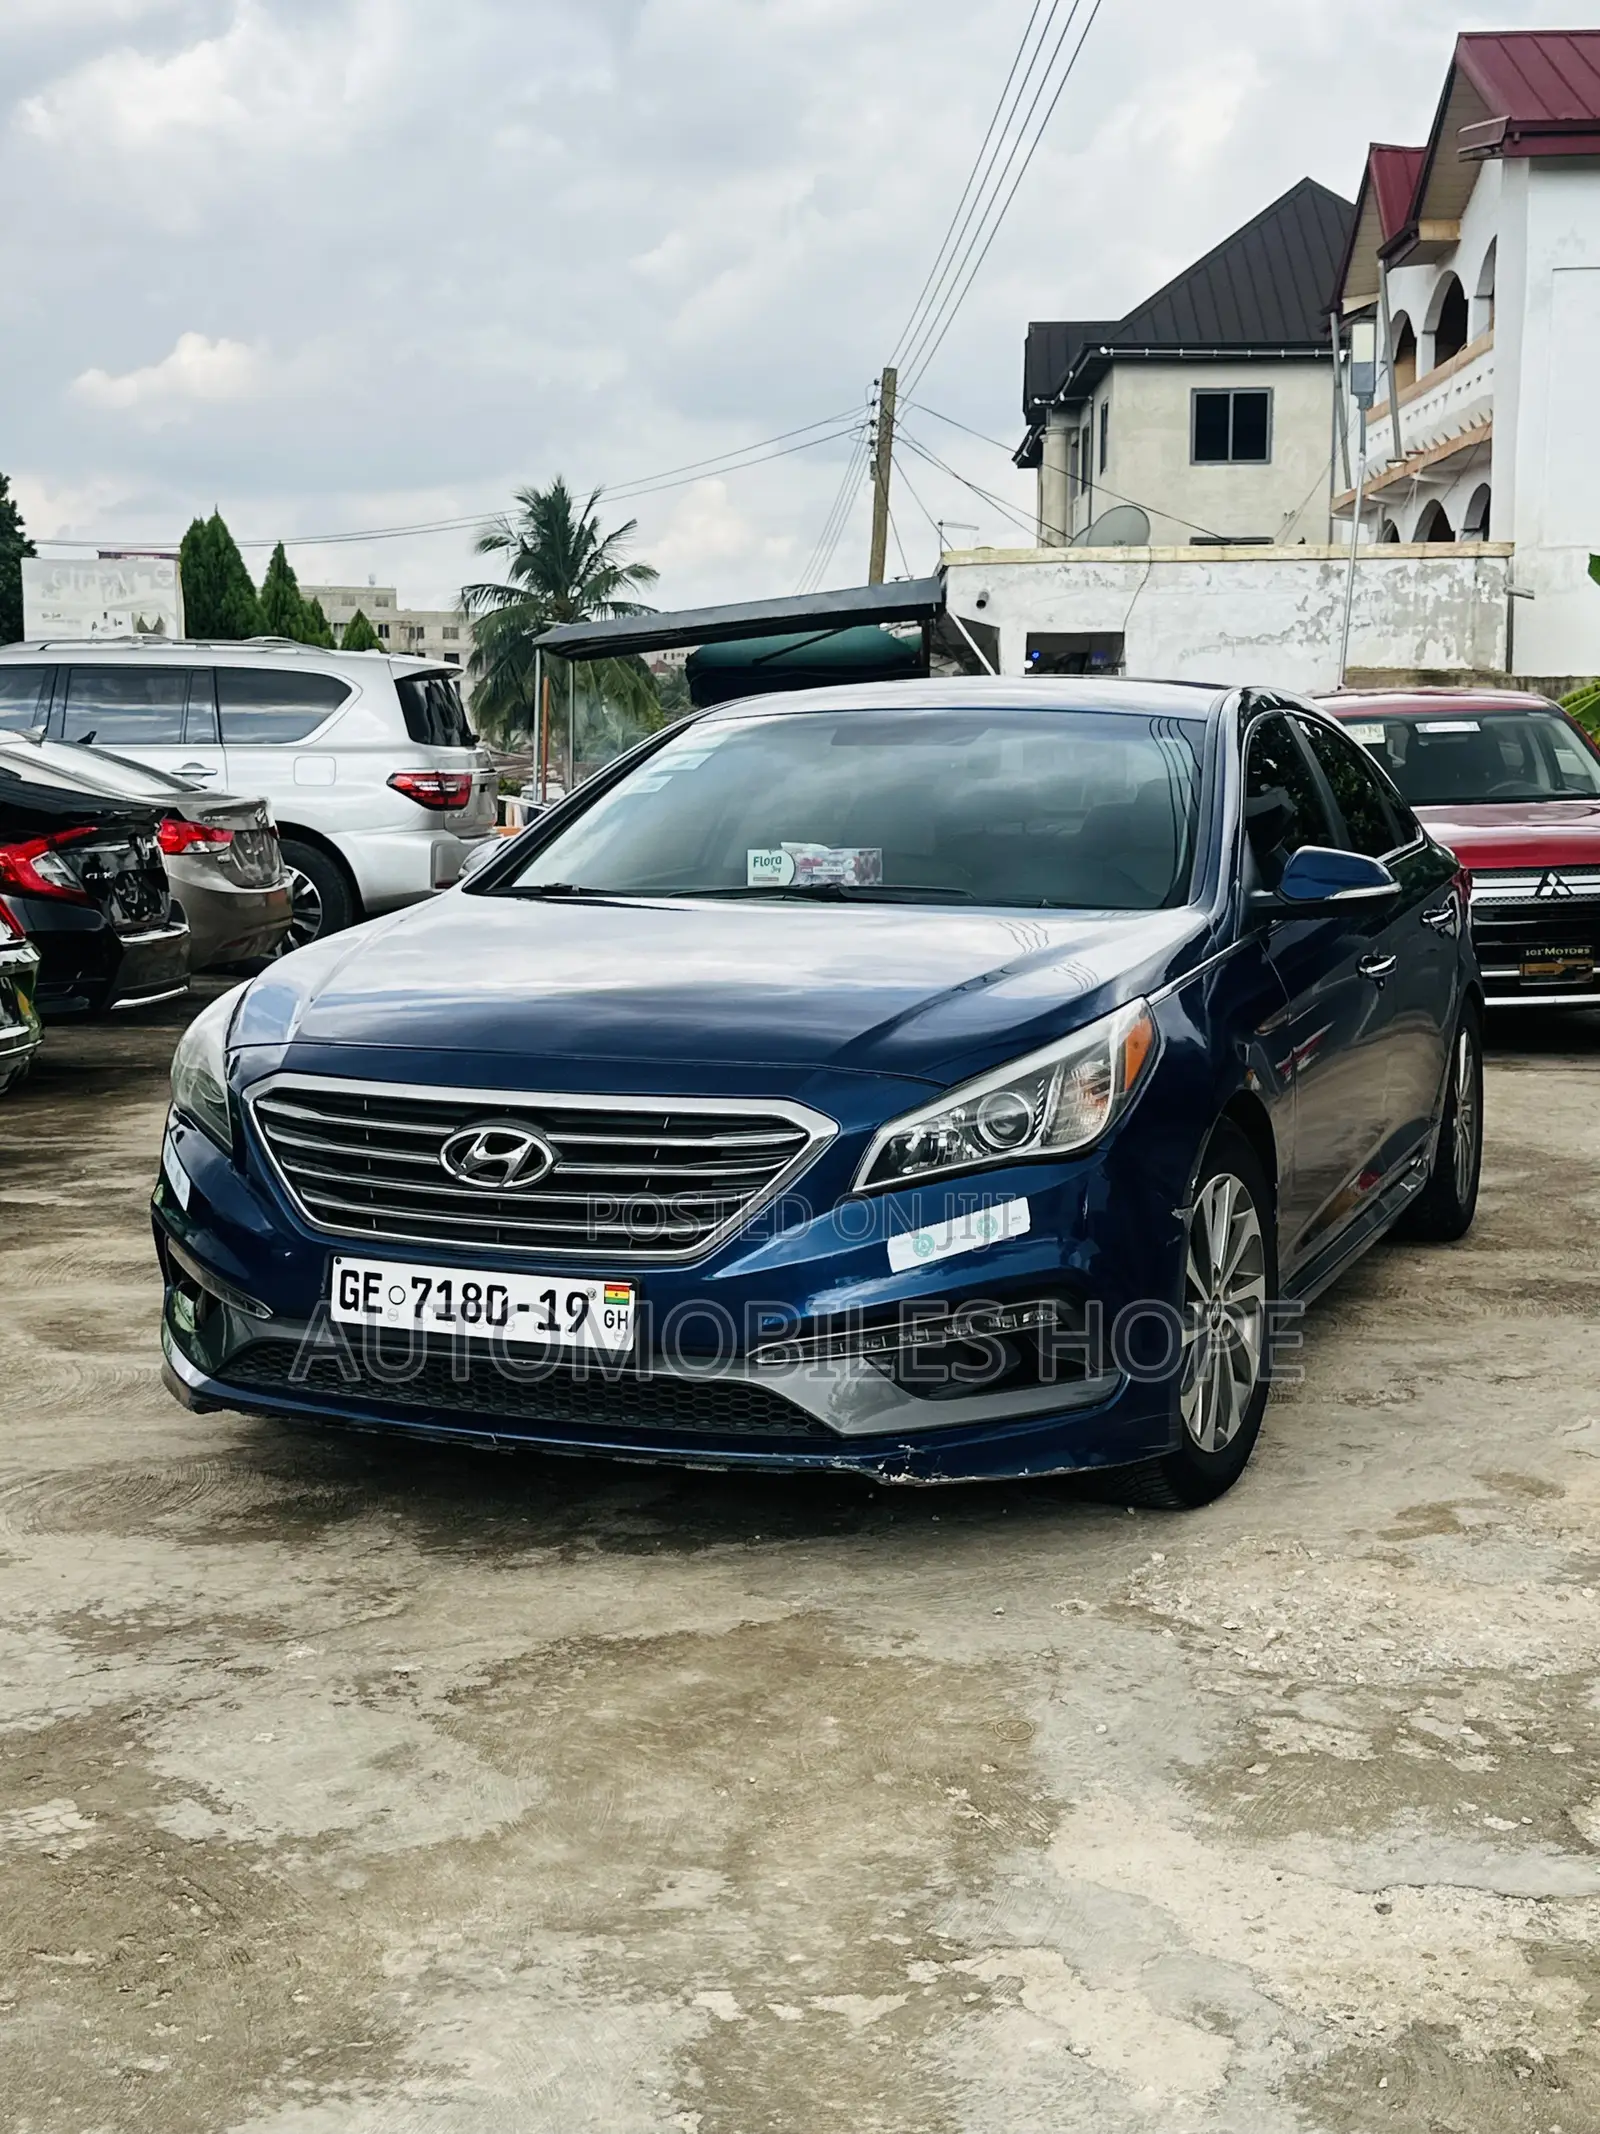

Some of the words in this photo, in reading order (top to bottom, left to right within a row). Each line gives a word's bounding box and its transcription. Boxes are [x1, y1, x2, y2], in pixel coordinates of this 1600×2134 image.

[753, 855, 782, 868] Flora
[339, 1269, 383, 1314] GE
[604, 1309, 628, 1330] GH
